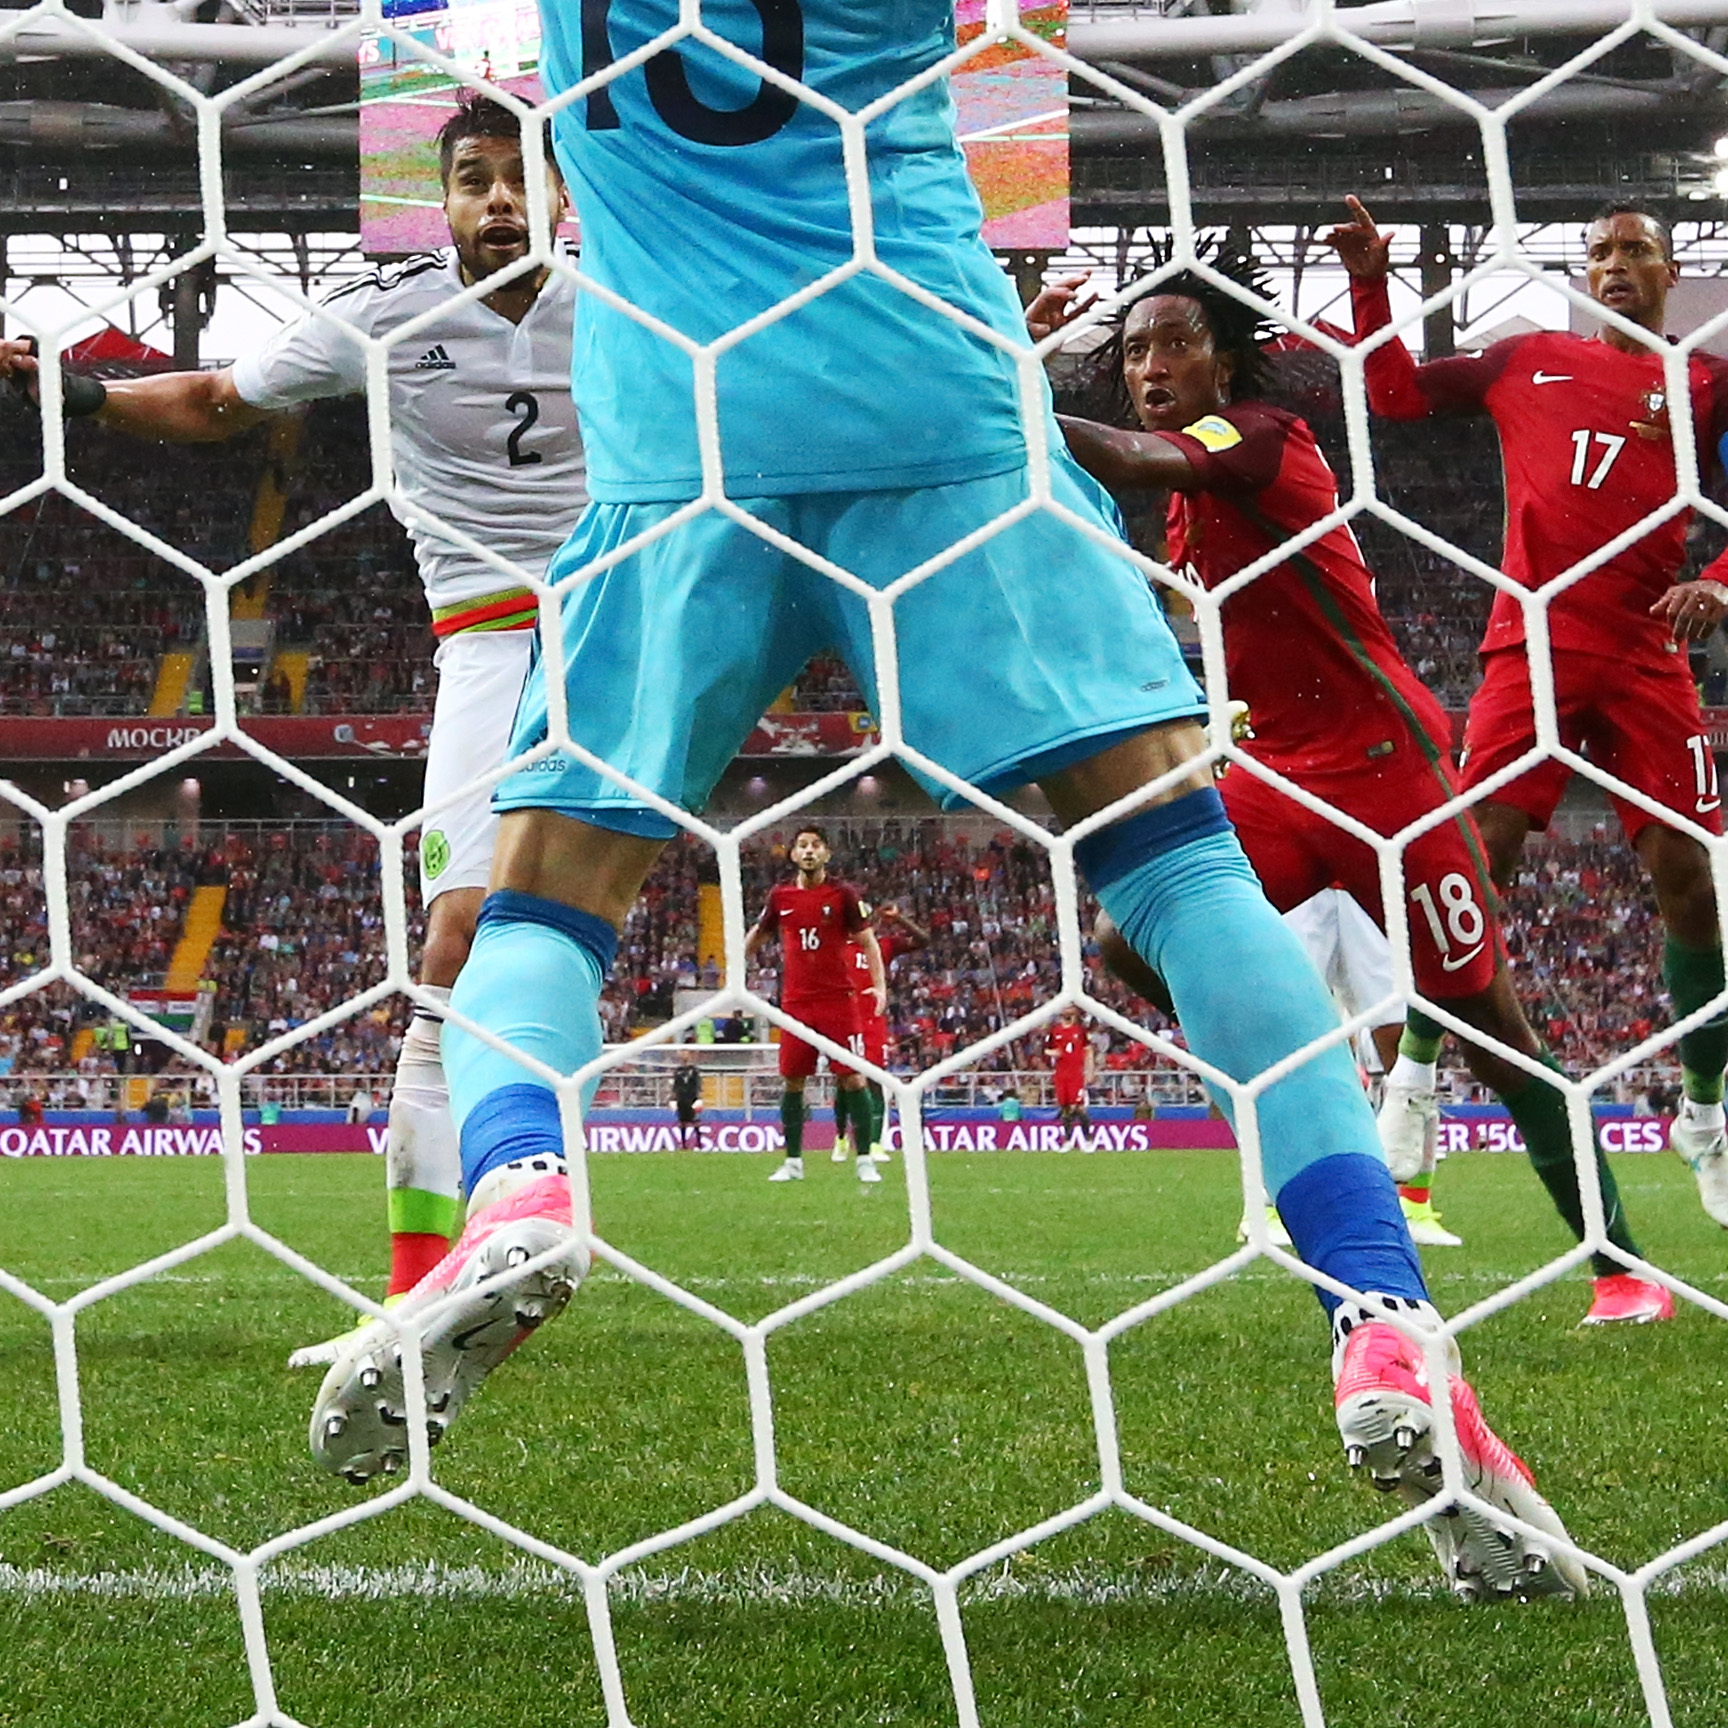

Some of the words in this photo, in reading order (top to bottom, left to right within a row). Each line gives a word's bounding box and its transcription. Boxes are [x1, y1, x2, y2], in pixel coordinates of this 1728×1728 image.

[505, 391, 542, 466] 2
[1571, 428, 1626, 490] 17
[107, 727, 202, 749] МОСКВ
[1410, 872, 1485, 954] 18
[799, 927, 820, 951] 16
[119, 1128, 262, 1156] AIRWAS
[1006, 1125, 1149, 1152] AIRWAYS
[1599, 1122, 1664, 1153] CES
